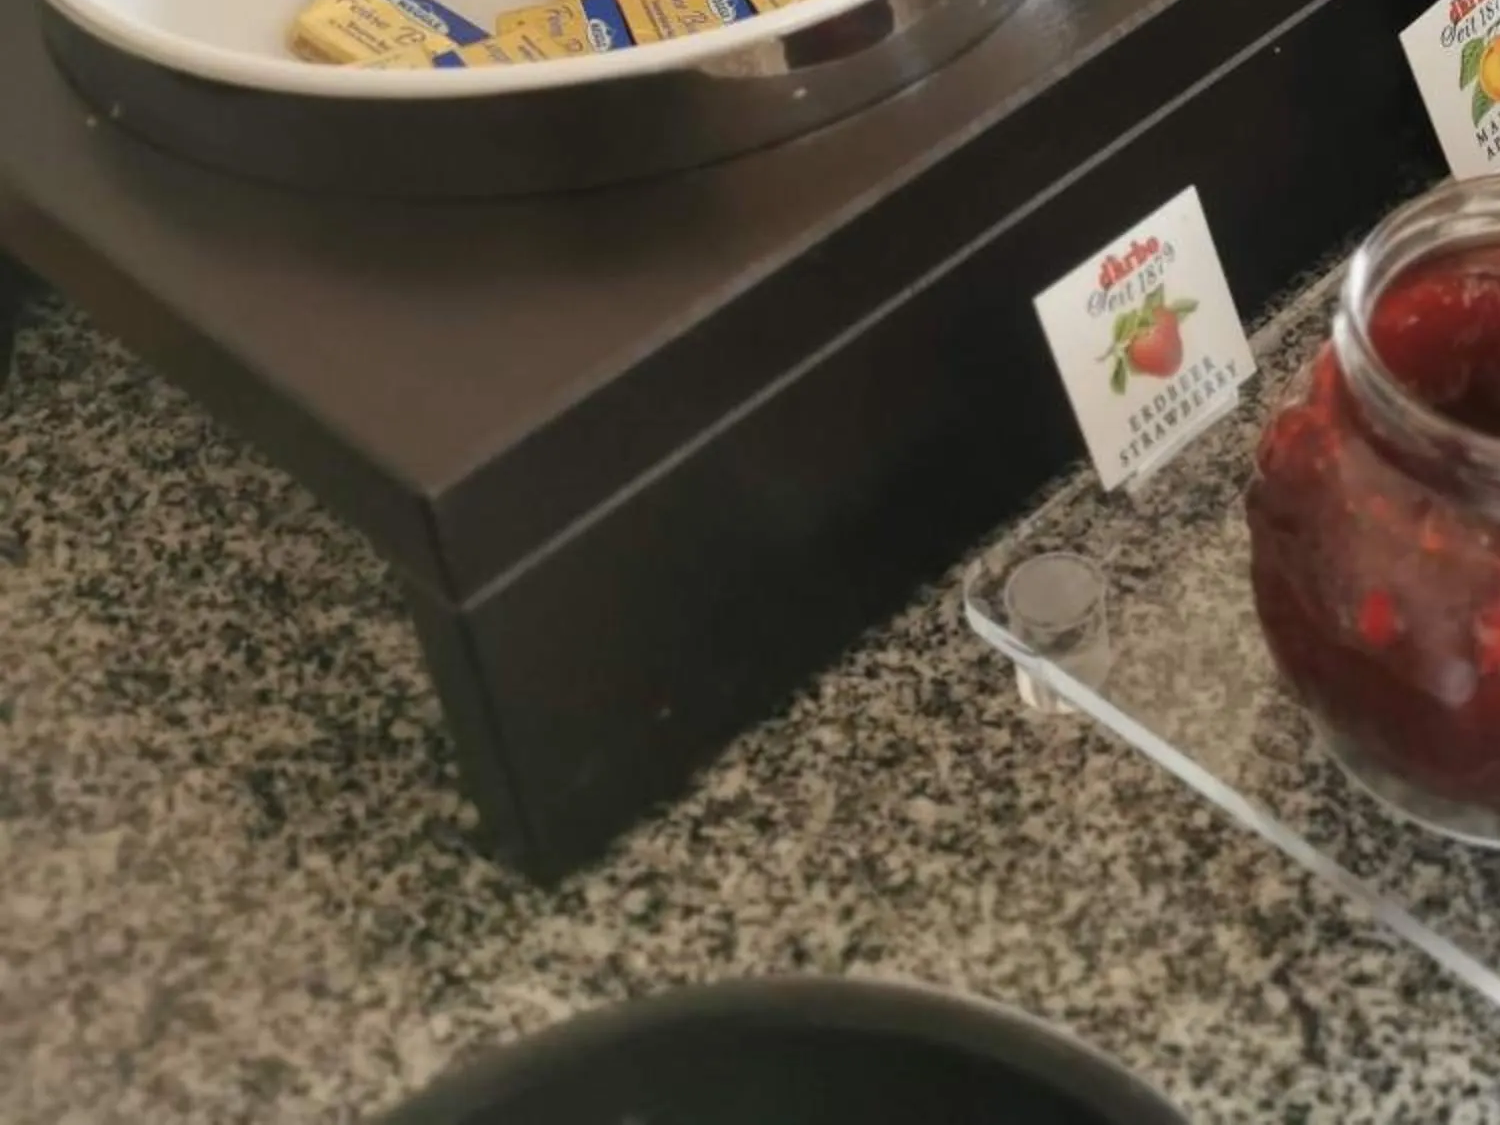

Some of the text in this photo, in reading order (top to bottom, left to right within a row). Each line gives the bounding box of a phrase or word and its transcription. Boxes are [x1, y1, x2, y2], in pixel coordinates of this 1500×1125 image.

[1440, 16, 1477, 49] Seit
[1118, 361, 1239, 468] STRAWBERRY
[1128, 354, 1217, 434] ERDBEER
